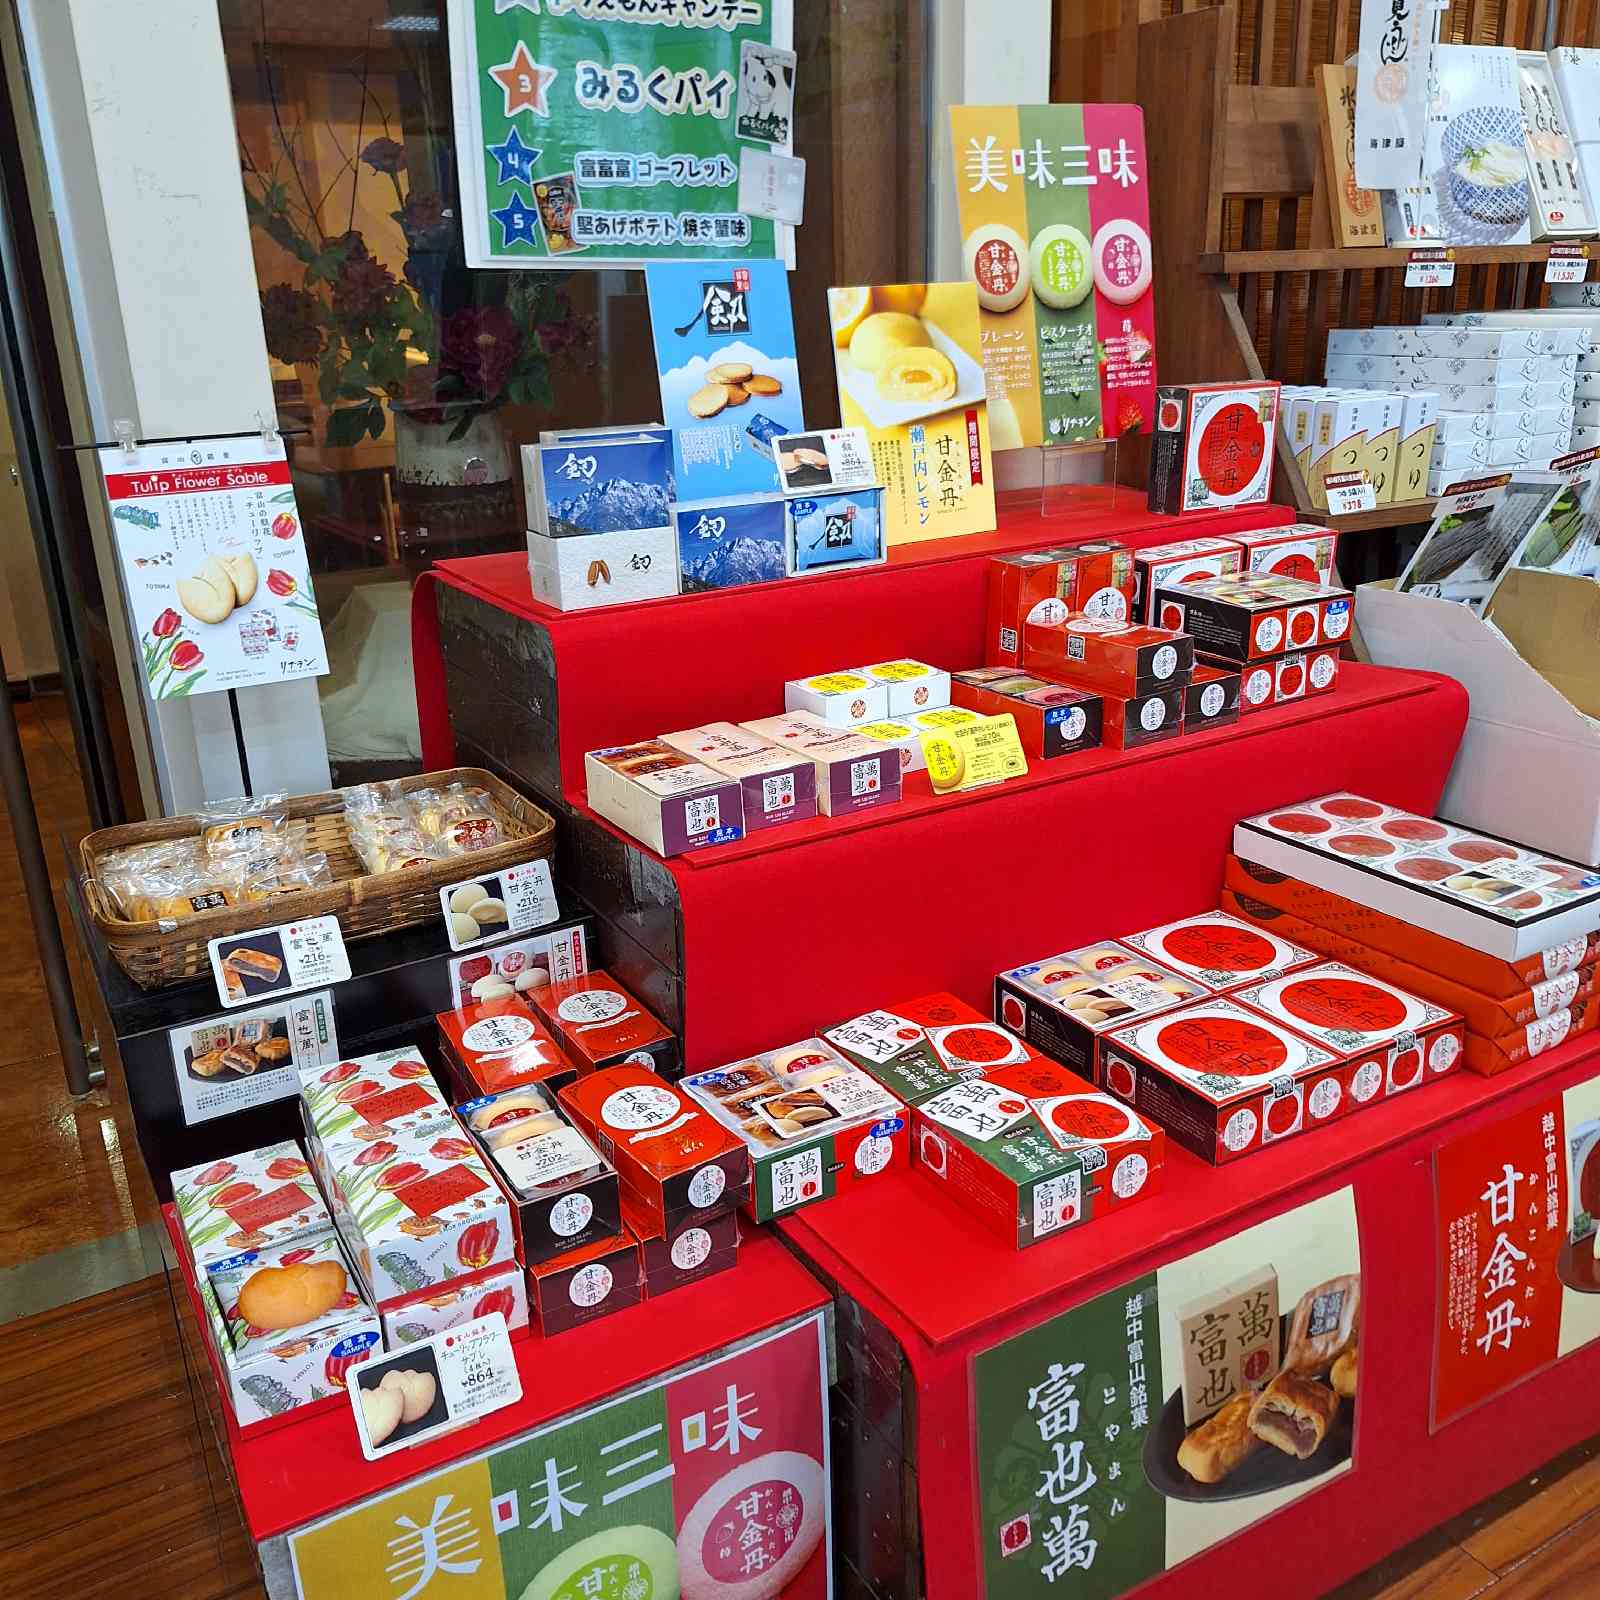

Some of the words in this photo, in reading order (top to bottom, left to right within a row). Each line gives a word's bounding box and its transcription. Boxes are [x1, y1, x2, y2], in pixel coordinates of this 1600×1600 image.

[518, 77, 531, 93] 3
[580, 67, 729, 110] みるくパイ
[508, 152, 518, 166] 4
[639, 159, 733, 178] ゴーフレット
[965, 135, 1139, 193] 美味三味
[513, 215, 524, 229] 5
[577, 215, 676, 237] 堅あげポテト
[682, 217, 747, 239] 焼き蟹味
[1222, 408, 1244, 489] 甘金丹
[1409, 443, 1425, 490] つり
[131, 475, 170, 495] Tulip
[175, 475, 221, 489] Flower
[227, 471, 268, 486] Sable
[909, 424, 931, 526] 瀬戸内レモン
[936, 434, 960, 507] 甘金丹
[508, 875, 545, 894] 甘金丹
[554, 940, 571, 982] 甘金丹
[575, 994, 610, 1020] 甘金丹
[483, 1019, 514, 1047] 甘金丹
[618, 1089, 668, 1124] 甘金丹
[516, 1140, 563, 1161] 甘金丹
[799, 1151, 819, 1177] 萬
[1540, 1111, 1560, 1232] 越中富山銘菓
[700, 1169, 713, 1206] 甘金丹
[775, 1160, 799, 1207] 富也
[1059, 1174, 1078, 1201] 萬
[562, 1196, 578, 1232] 甘金丹
[1036, 1183, 1059, 1231] 富也
[685, 1231, 699, 1264] 甘金丹
[1476, 1163, 1529, 1357] 甘金丹
[583, 1268, 597, 1304] 甘金丹
[1235, 1290, 1275, 1350] 萬
[341, 1341, 373, 1357] SAMPLE
[342, 1333, 368, 1350] 見本
[1123, 1294, 1150, 1431] 越中富山銘菓
[1188, 1312, 1237, 1409] 富也
[461, 1367, 495, 1388] ¥864
[1026, 1359, 1098, 1583] 富也萬
[1103, 1384, 1128, 1518] とやまん
[385, 1383, 765, 1600] 美味三味
[734, 1489, 771, 1577] 甘金丹
